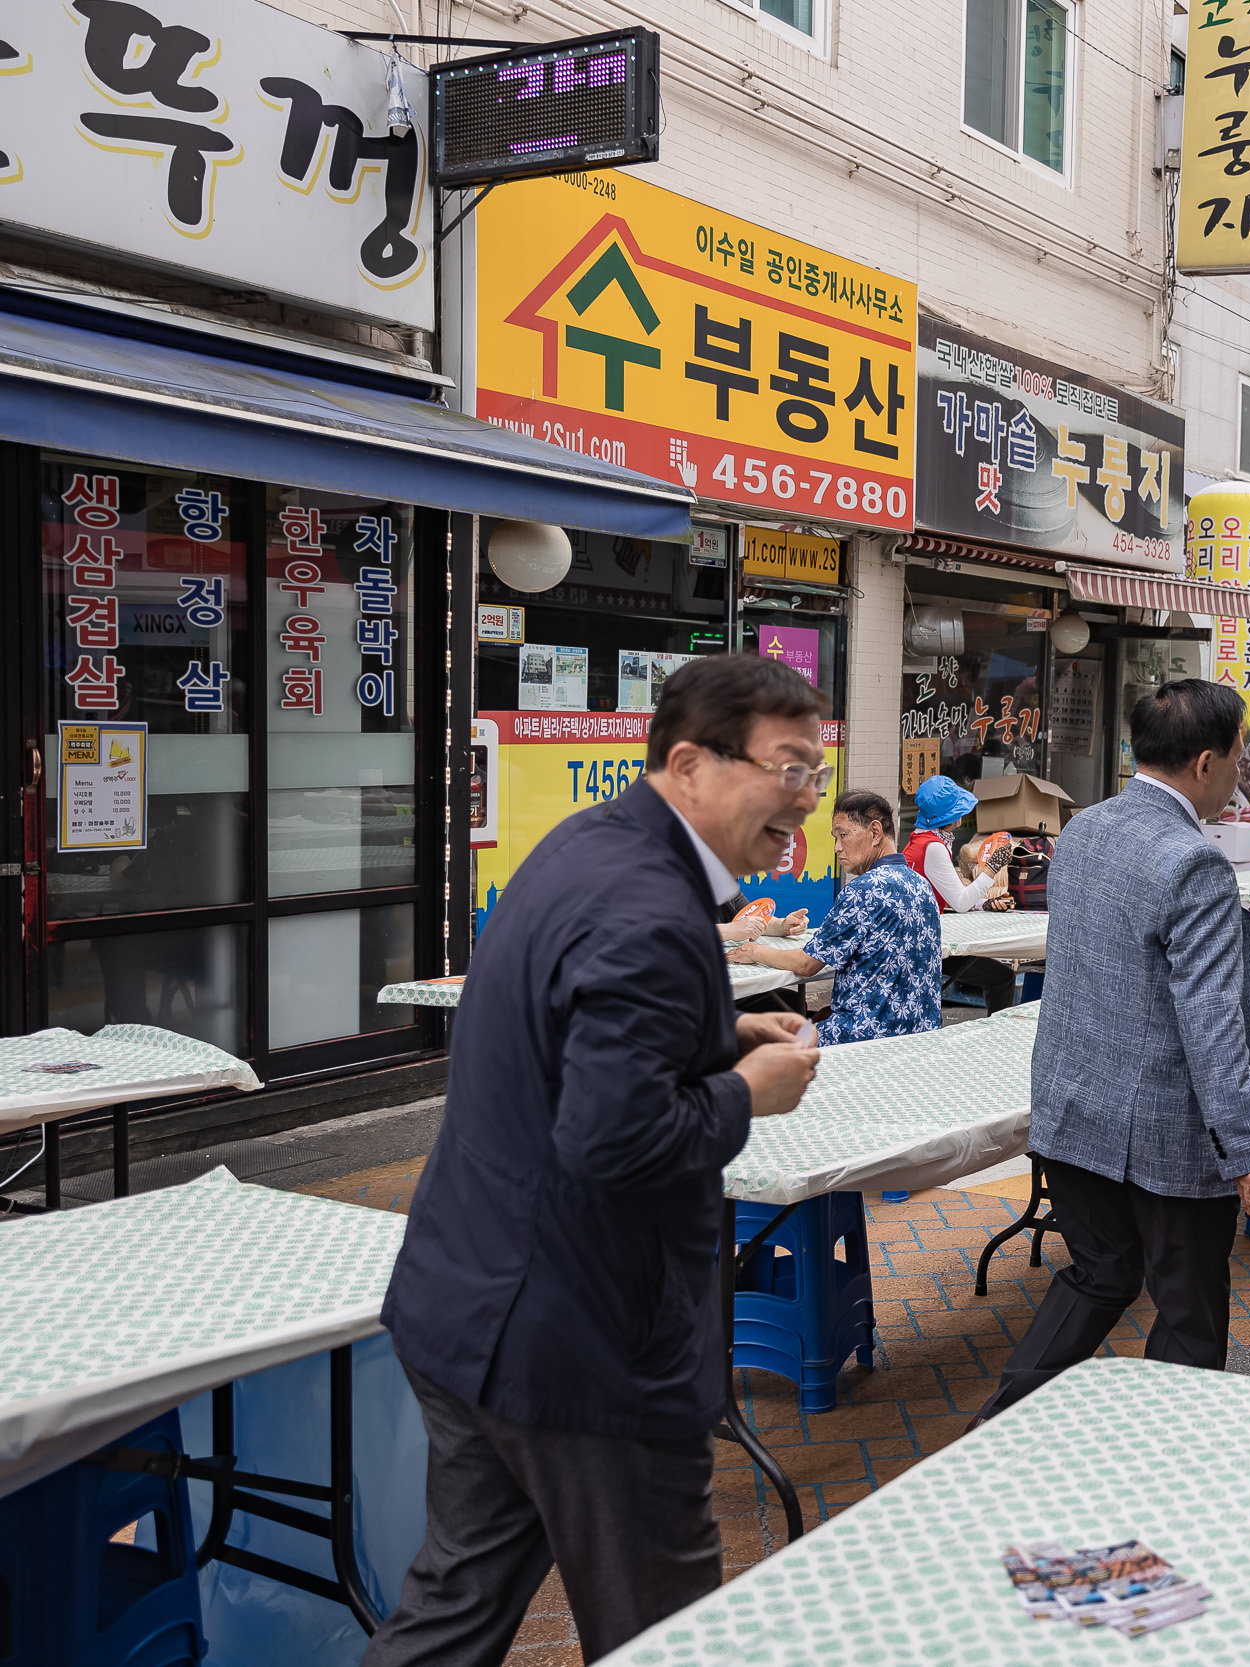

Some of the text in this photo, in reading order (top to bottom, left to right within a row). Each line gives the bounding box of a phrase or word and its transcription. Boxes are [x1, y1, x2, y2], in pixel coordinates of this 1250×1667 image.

[695, 225, 904, 325] 이수일 공인중개사사무소
[566, 241, 906, 461] 수 부동산
[937, 390, 1038, 472] 가마솥
[712, 453, 907, 519] 456-7880
[975, 462, 1002, 515] 맛
[1052, 421, 1171, 530] 누룽지
[1112, 533, 1171, 561] 454-3328
[61, 474, 126, 710] 생삼겹살
[175, 488, 231, 713] 항정살
[279, 506, 327, 717] 한우육회
[353, 515, 399, 717] 차돌박이
[481, 615, 504, 626] 2억원
[785, 651, 813, 663] 부동산
[68, 751, 94, 760] MENU
[901, 701, 968, 740] 가마솥맛
[970, 696, 1042, 745] 누룽지
